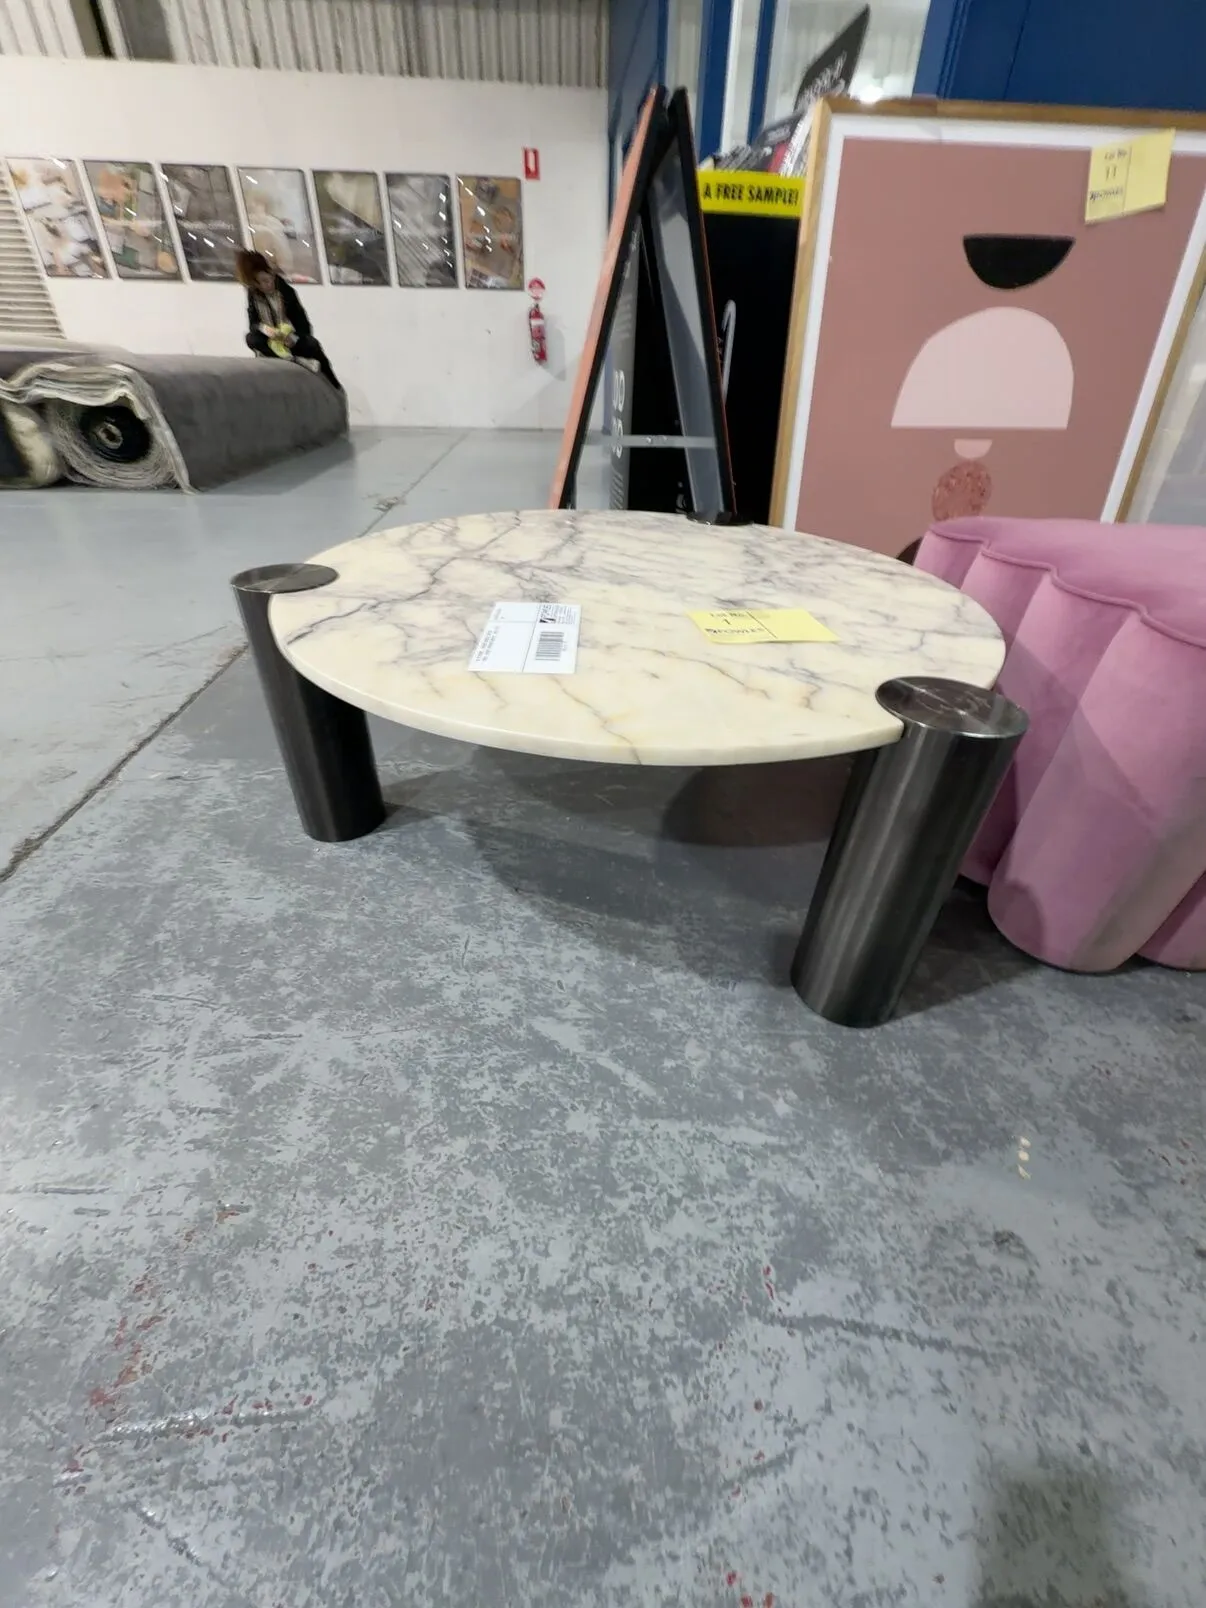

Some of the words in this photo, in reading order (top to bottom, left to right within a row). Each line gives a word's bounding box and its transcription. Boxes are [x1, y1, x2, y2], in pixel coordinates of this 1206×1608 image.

[703, 182, 712, 200] A
[715, 182, 744, 201] FREE
[747, 185, 799, 206] SAMPLE!
